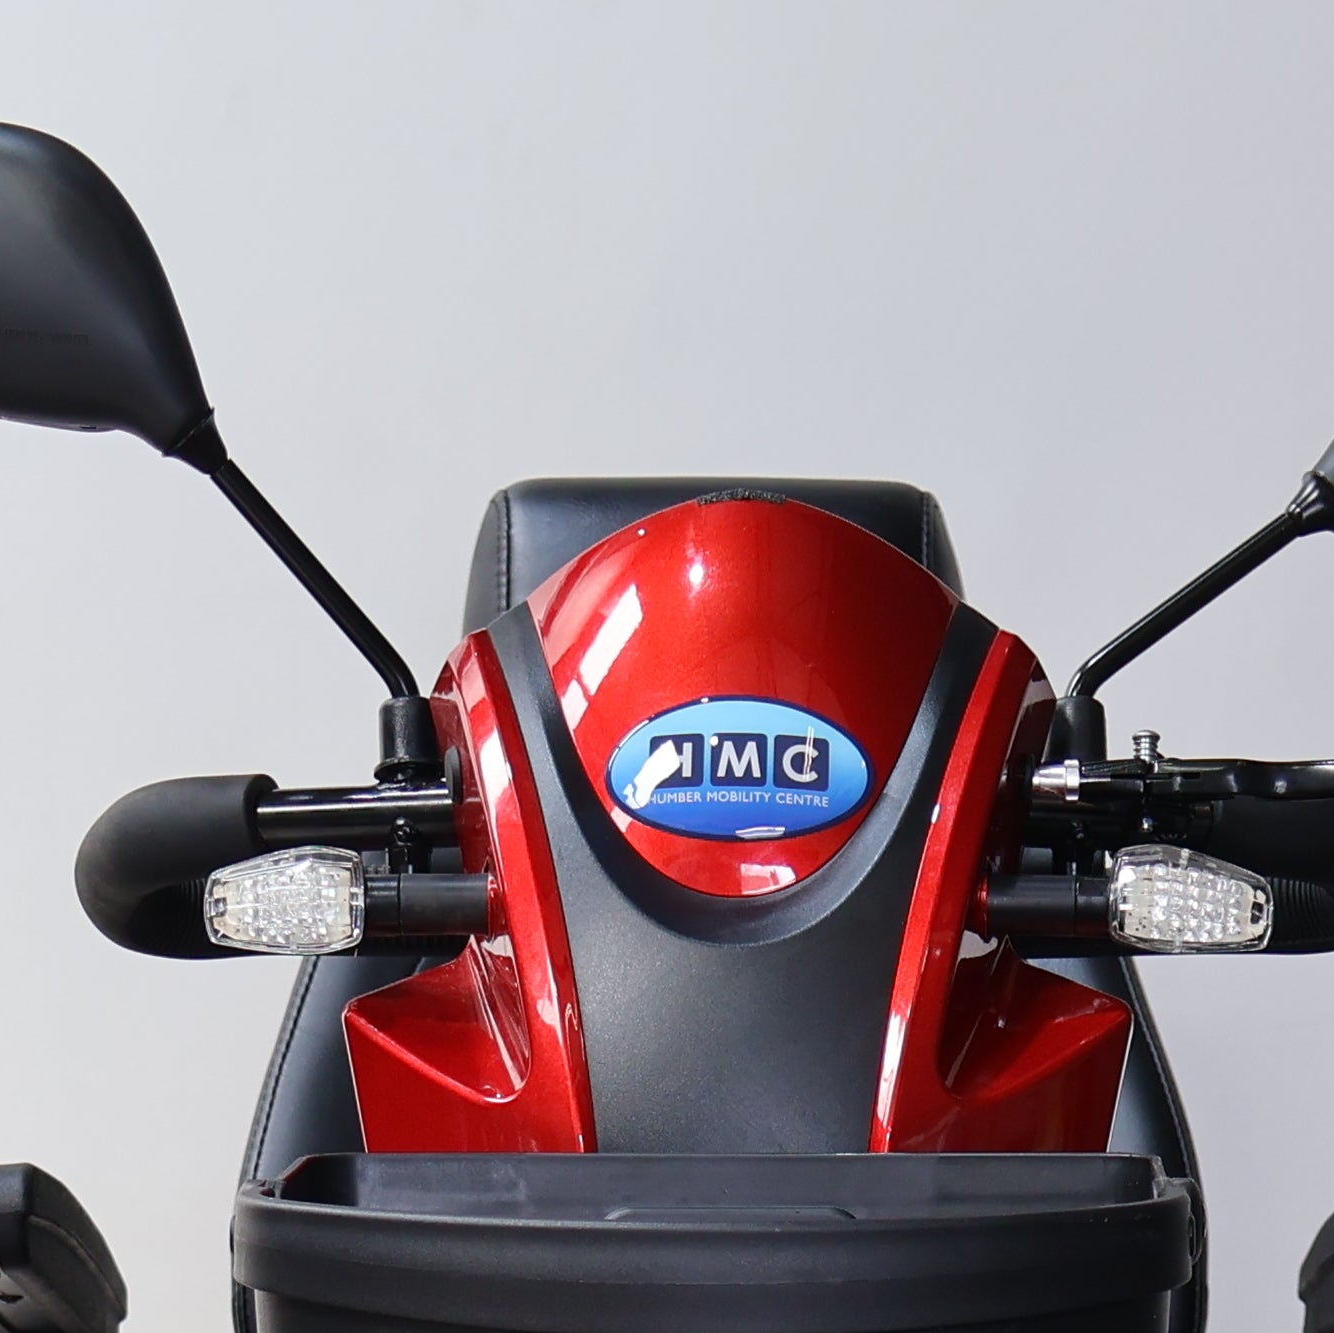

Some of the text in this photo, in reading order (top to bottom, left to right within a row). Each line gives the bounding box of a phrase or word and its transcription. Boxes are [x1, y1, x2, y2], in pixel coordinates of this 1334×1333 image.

[649, 790, 830, 808] HUMBER MOBILITY CENTRE
